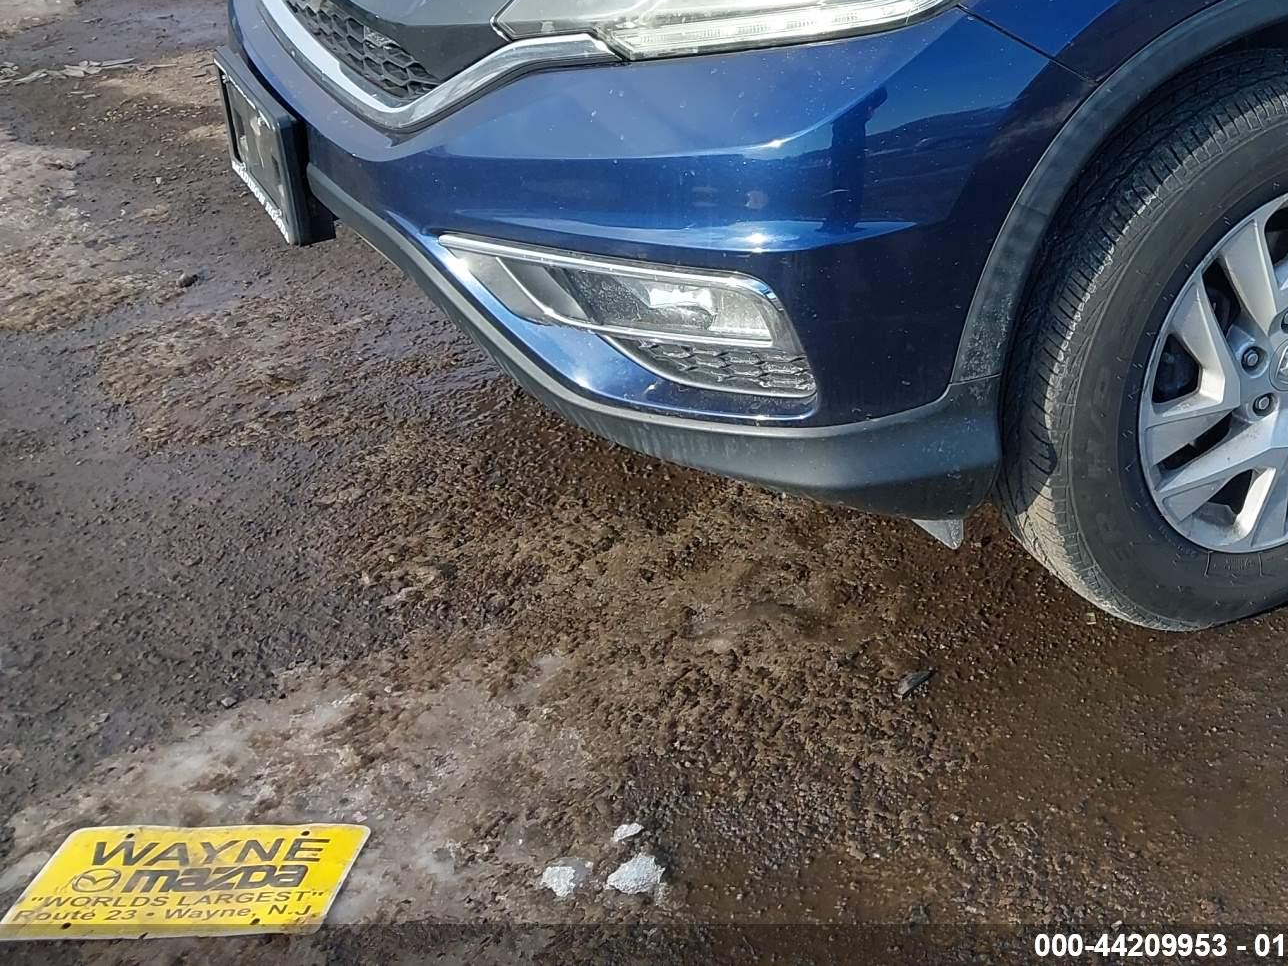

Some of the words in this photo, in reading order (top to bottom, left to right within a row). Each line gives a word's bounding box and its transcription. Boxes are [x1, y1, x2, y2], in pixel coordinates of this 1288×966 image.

[92, 837, 331, 867] WAYNE
[121, 864, 309, 894] mazda
[103, 909, 138, 921] 23
